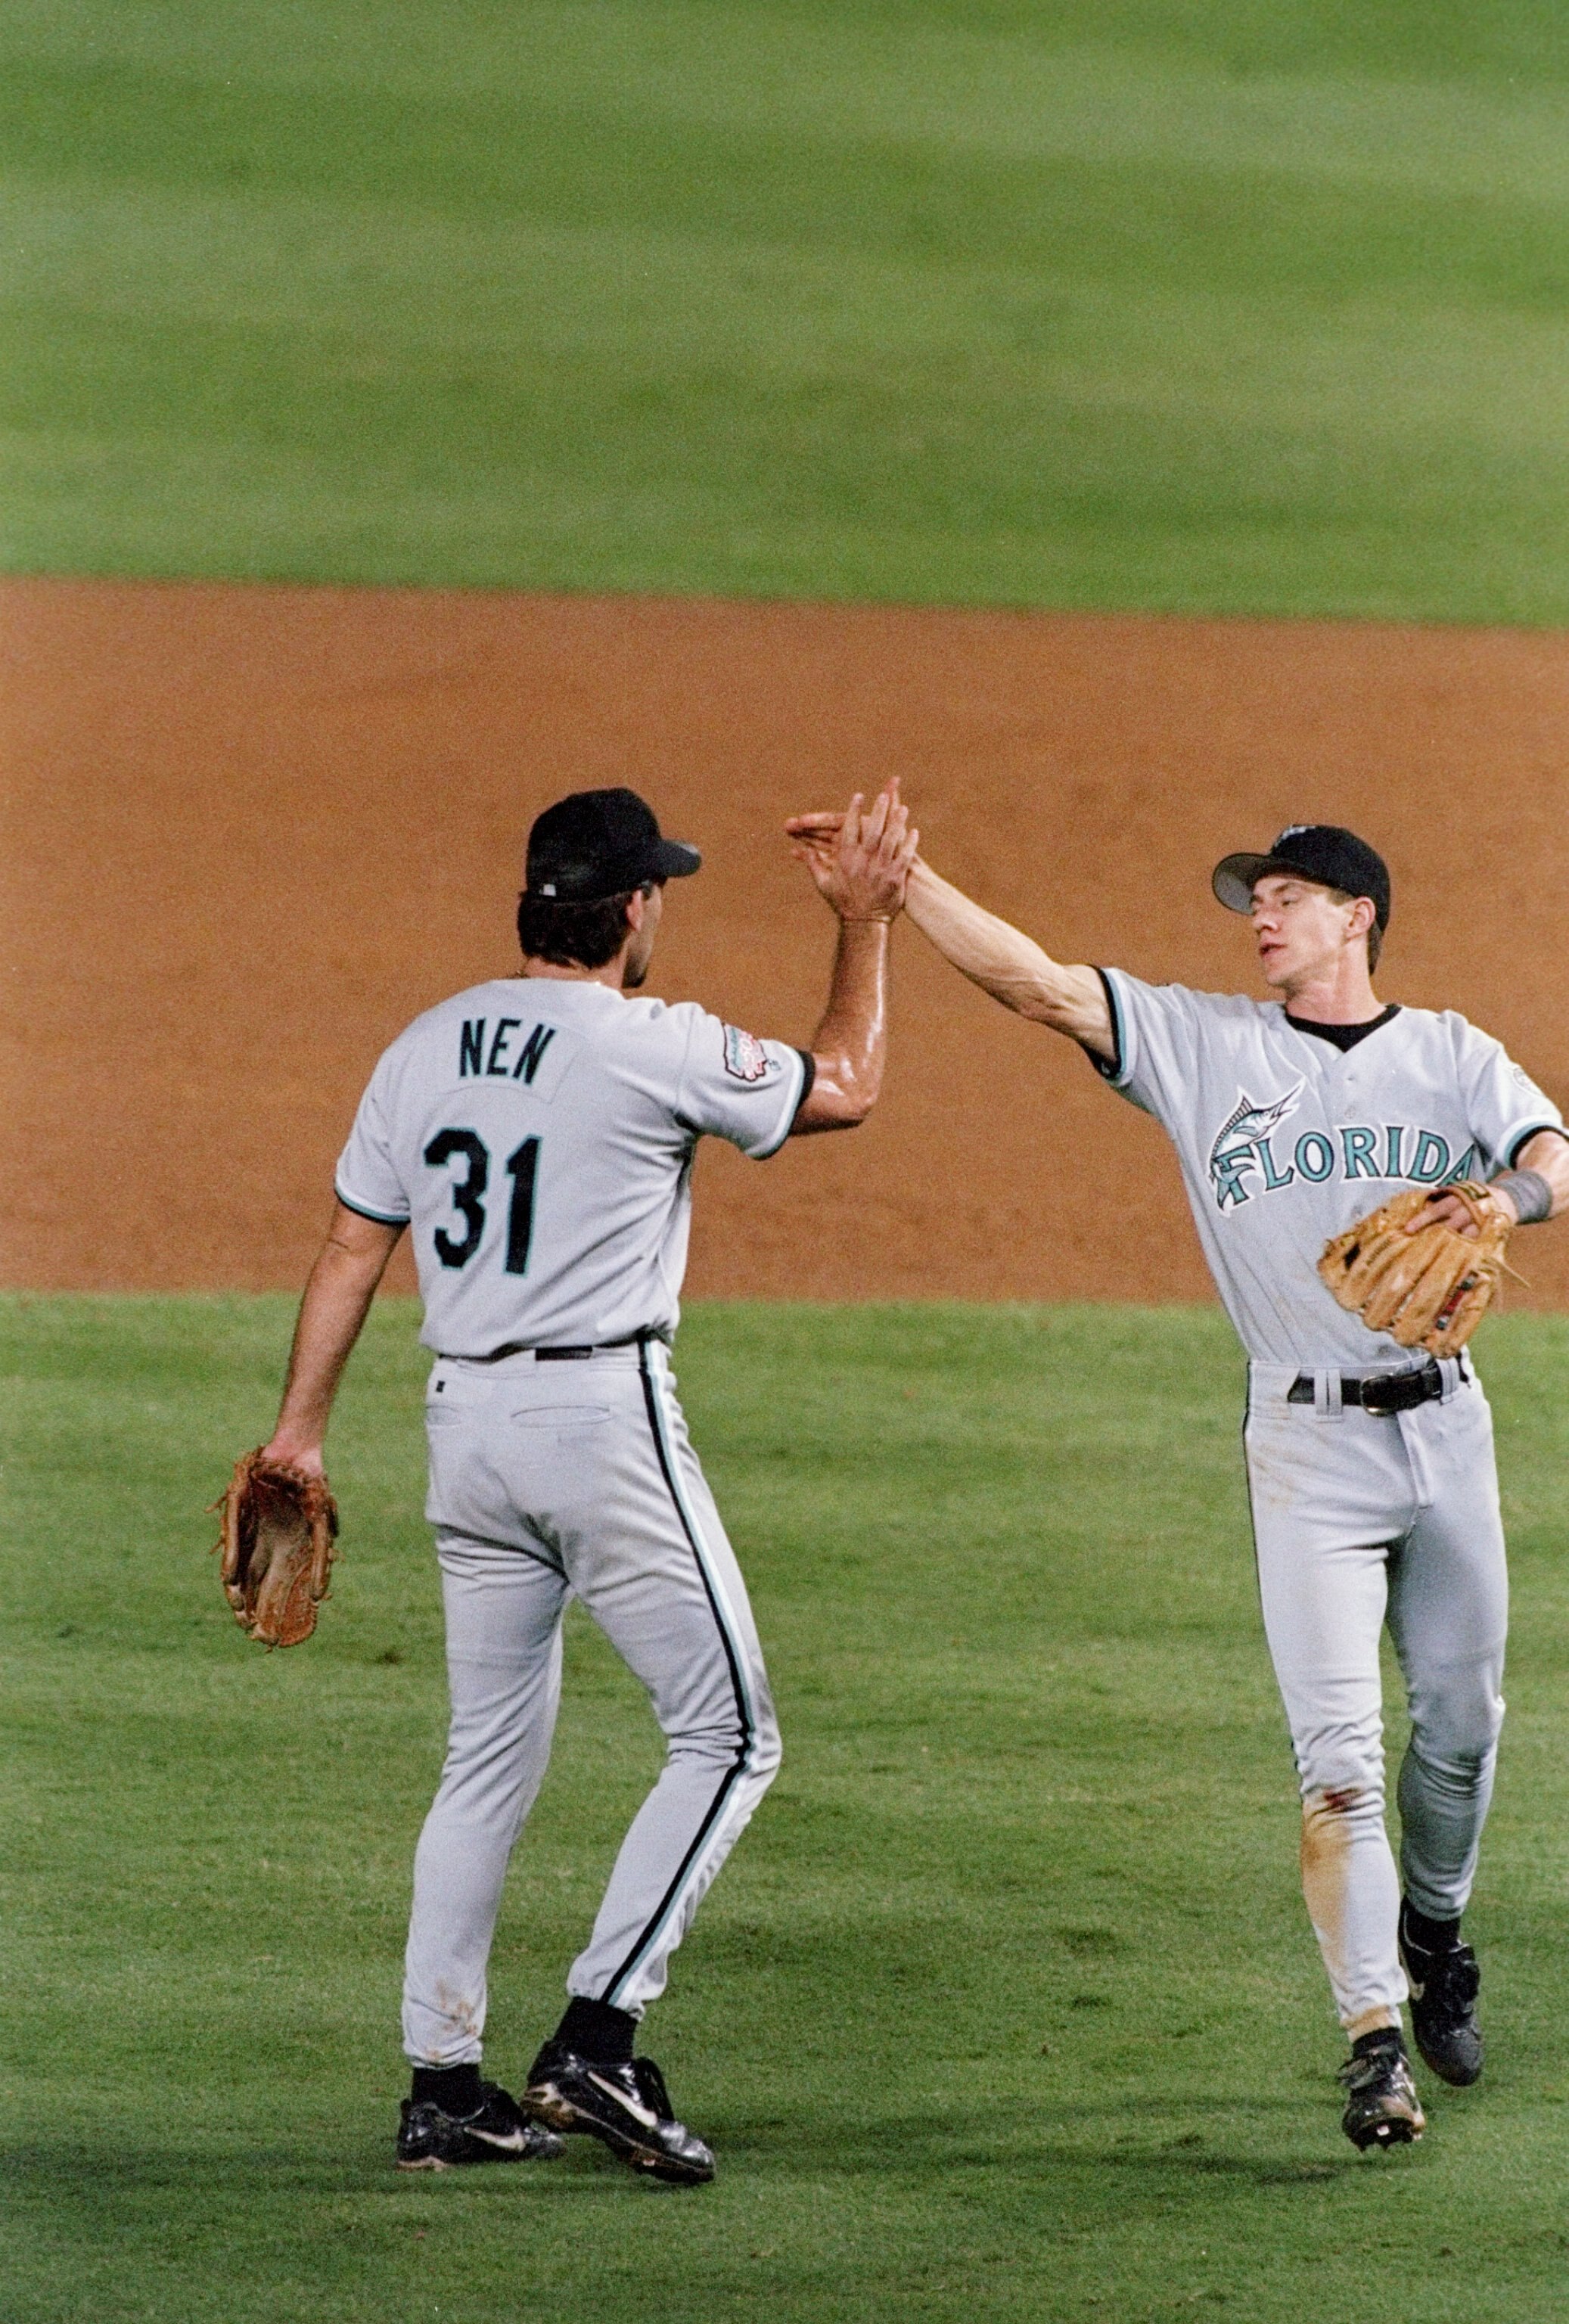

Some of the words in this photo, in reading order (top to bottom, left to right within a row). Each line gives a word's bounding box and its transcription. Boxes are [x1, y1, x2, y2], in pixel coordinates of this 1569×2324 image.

[459, 1018, 556, 1085] NEN
[424, 1126, 543, 1276] 31
[1211, 1126, 1474, 1206] FLORIDA
